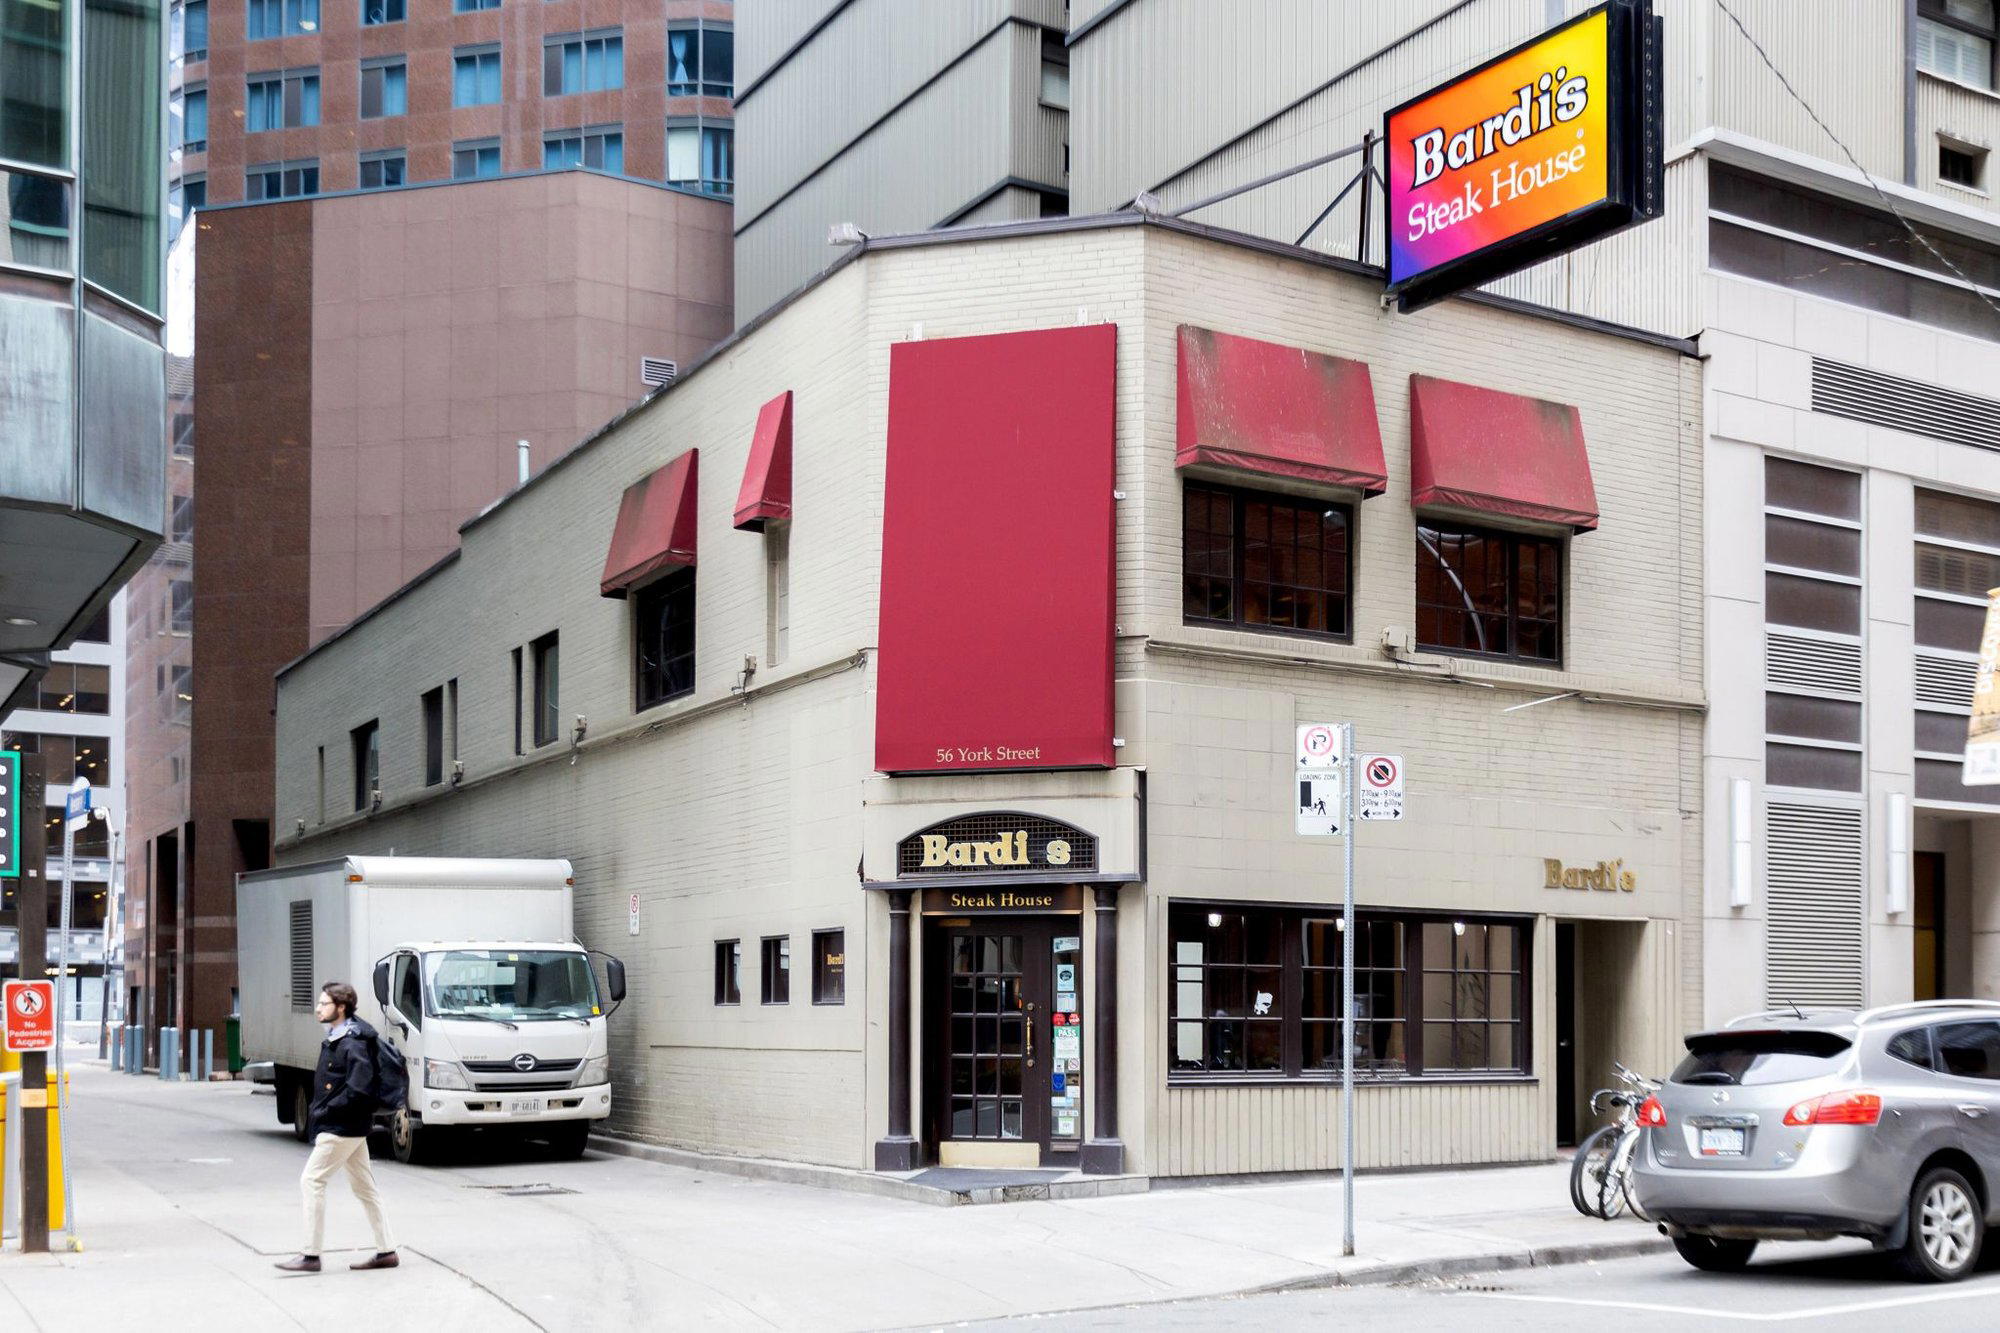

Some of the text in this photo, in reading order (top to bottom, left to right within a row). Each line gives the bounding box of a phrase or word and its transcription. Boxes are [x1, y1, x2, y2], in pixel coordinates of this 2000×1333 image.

[1409, 66, 1588, 192] Bardi's
[1408, 143, 1586, 242] Steak House
[936, 746, 1040, 764] 56 York Street
[1544, 858, 1635, 892] Bardi's
[951, 893, 1052, 907] Steak House
[1058, 1029, 1077, 1037] PASS
